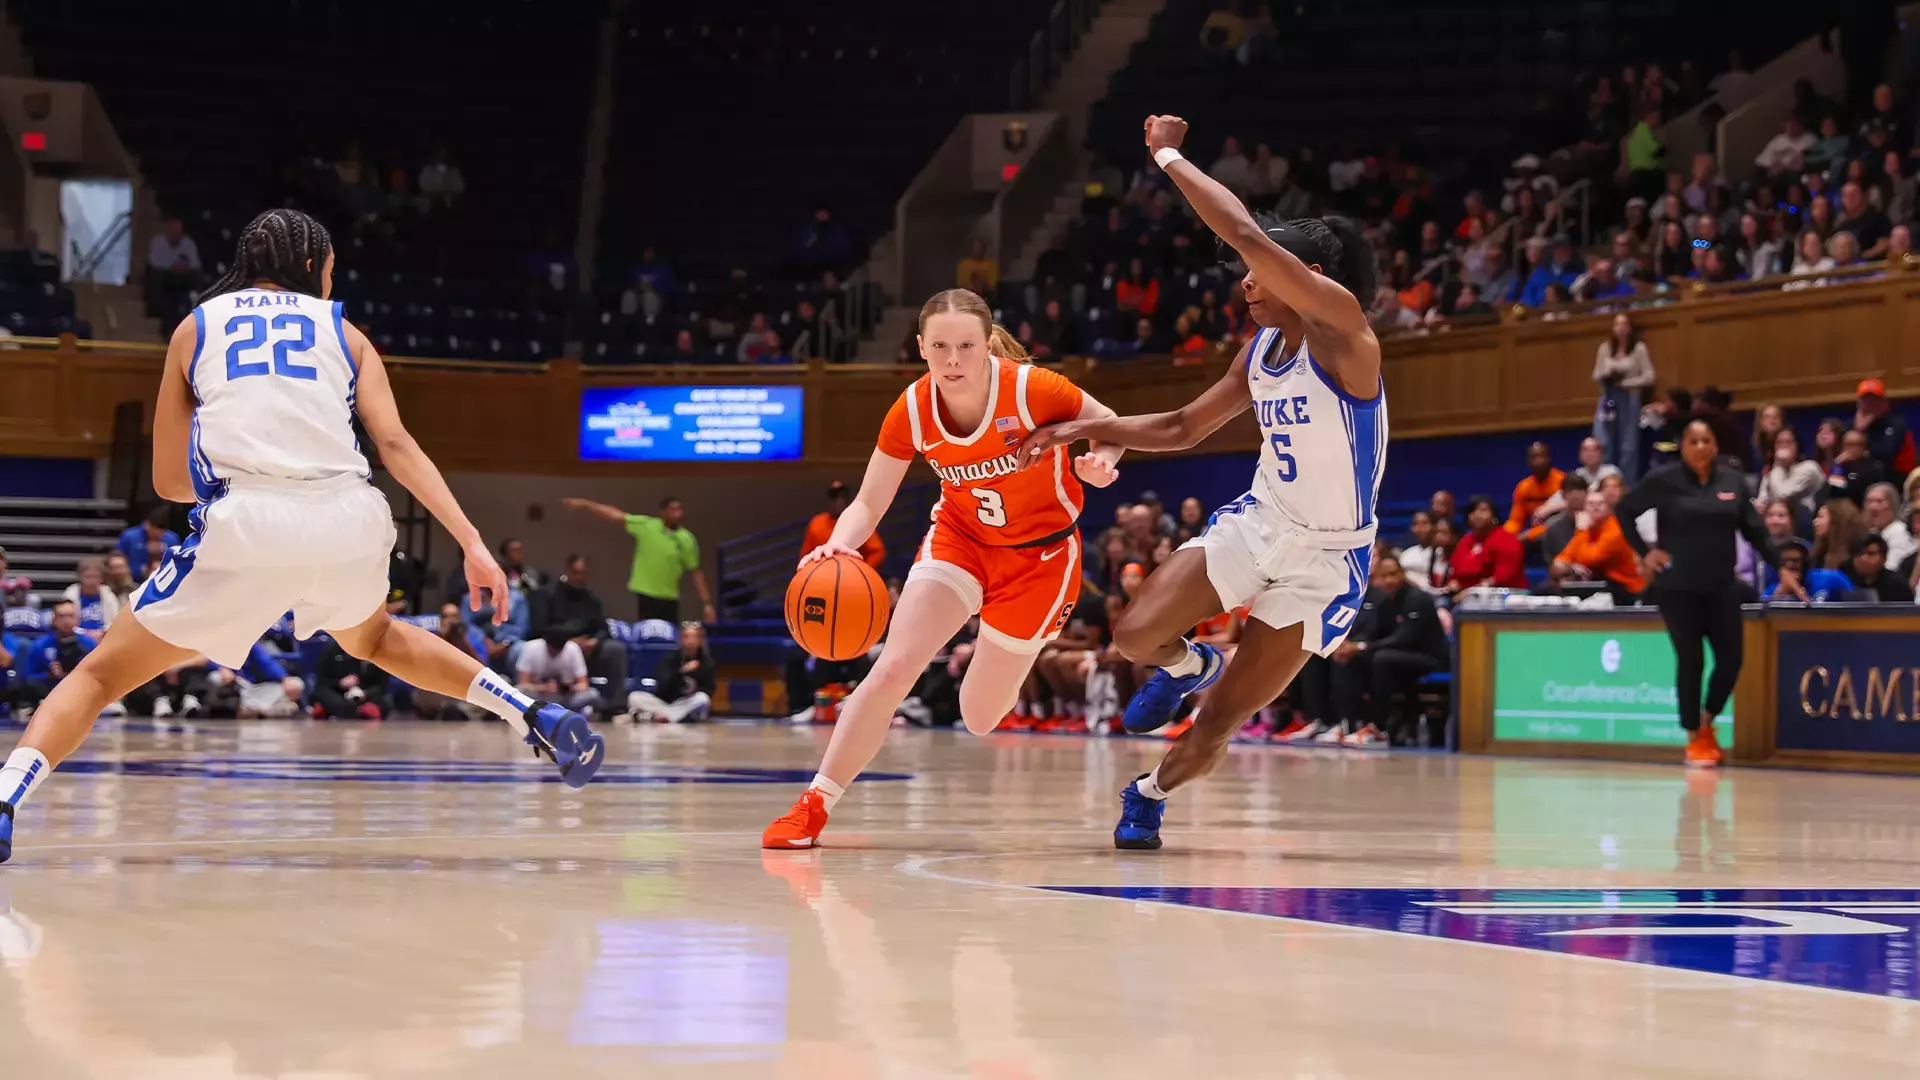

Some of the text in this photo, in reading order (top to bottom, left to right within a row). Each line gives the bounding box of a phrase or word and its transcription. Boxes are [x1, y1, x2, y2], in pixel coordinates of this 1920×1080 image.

[234, 295, 300, 309] MAIR
[224, 313, 317, 381] 22
[929, 446, 1022, 487] Syracus
[1270, 433, 1298, 482] 5
[970, 487, 1008, 527] 3
